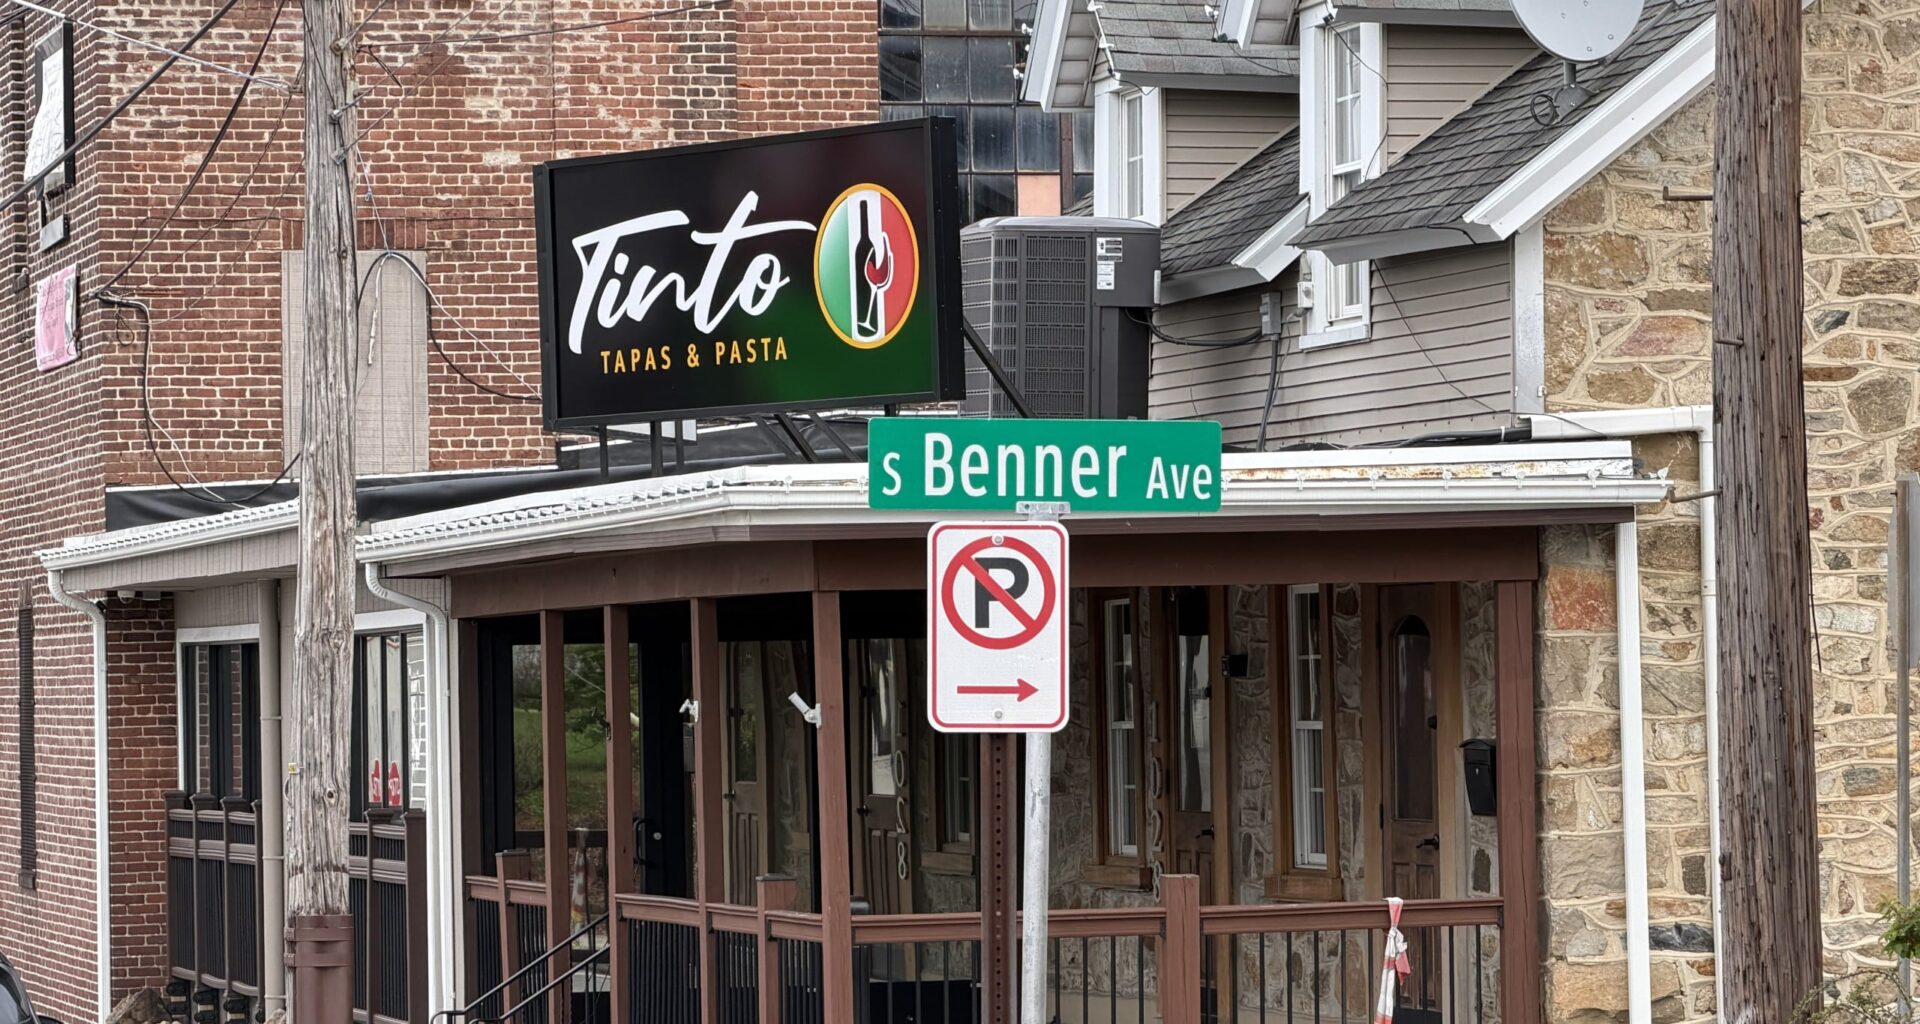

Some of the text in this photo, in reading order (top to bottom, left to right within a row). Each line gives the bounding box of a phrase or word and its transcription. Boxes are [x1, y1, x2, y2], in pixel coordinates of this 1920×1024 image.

[568, 190, 817, 354] Tinto
[600, 336, 788, 374] TAPAS & PASTA
[882, 432, 1212, 499] S Benner Ave
[975, 557, 1030, 628] P
[1149, 700, 1163, 903] 1028
